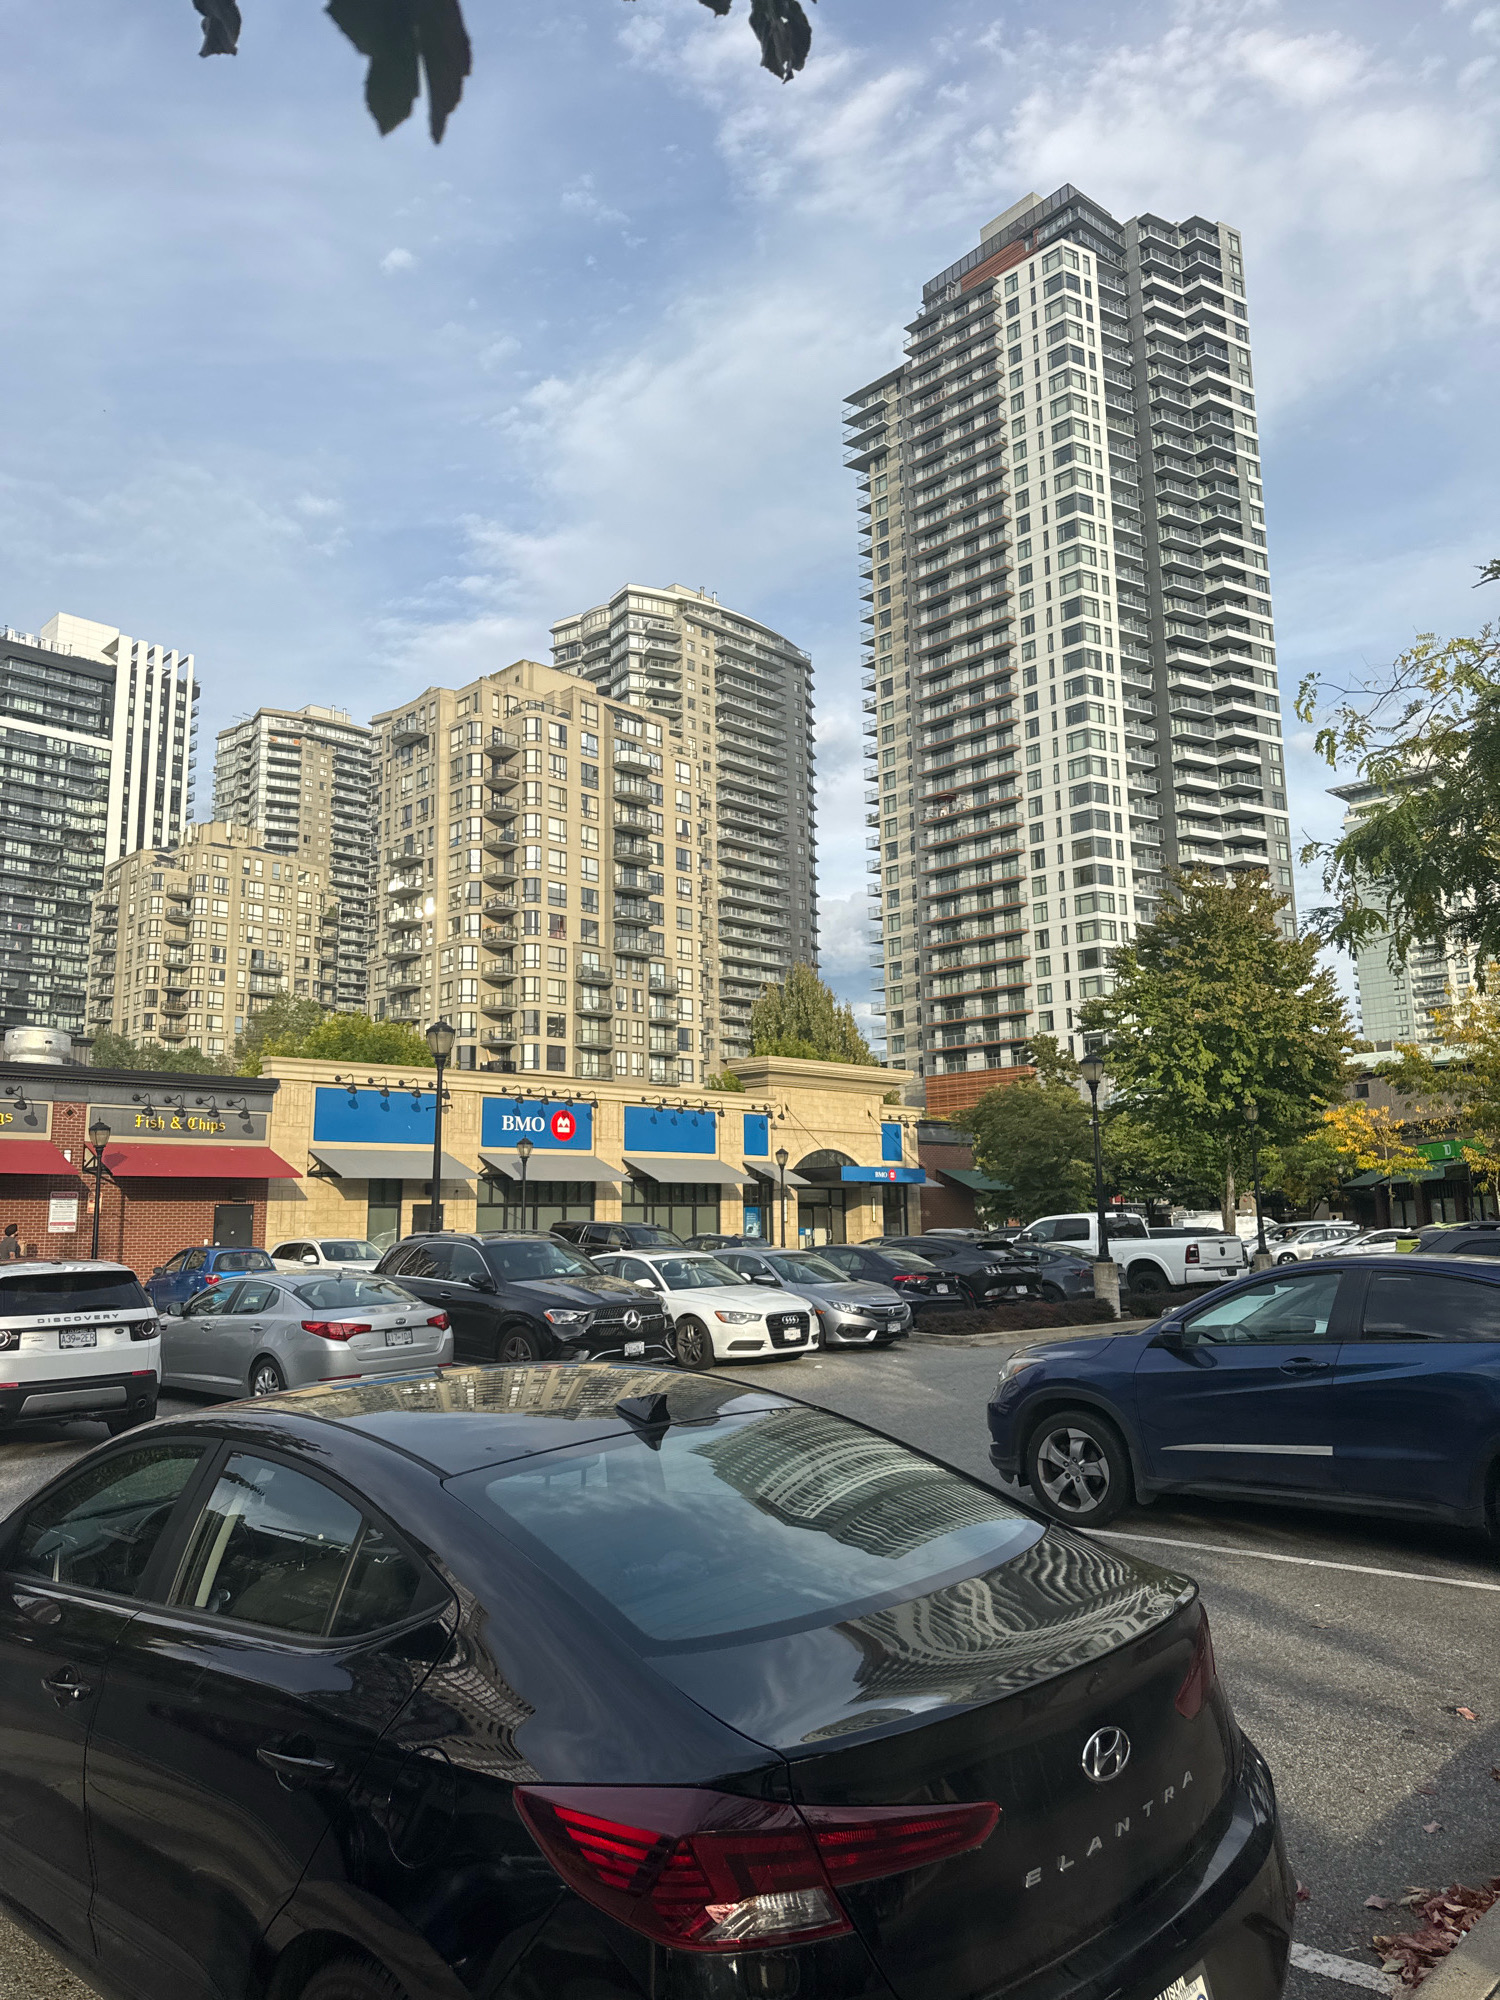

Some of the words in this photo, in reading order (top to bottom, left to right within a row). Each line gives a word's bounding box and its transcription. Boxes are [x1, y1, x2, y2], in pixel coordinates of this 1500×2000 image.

[134, 1114, 165, 1130] Fish
[170, 1116, 183, 1130] &
[187, 1116, 226, 1135] Chips
[501, 1115, 546, 1132] BMO
[37, 1313, 119, 1324] DISCOVERY
[1023, 1770, 1194, 1889] ELANTRA
